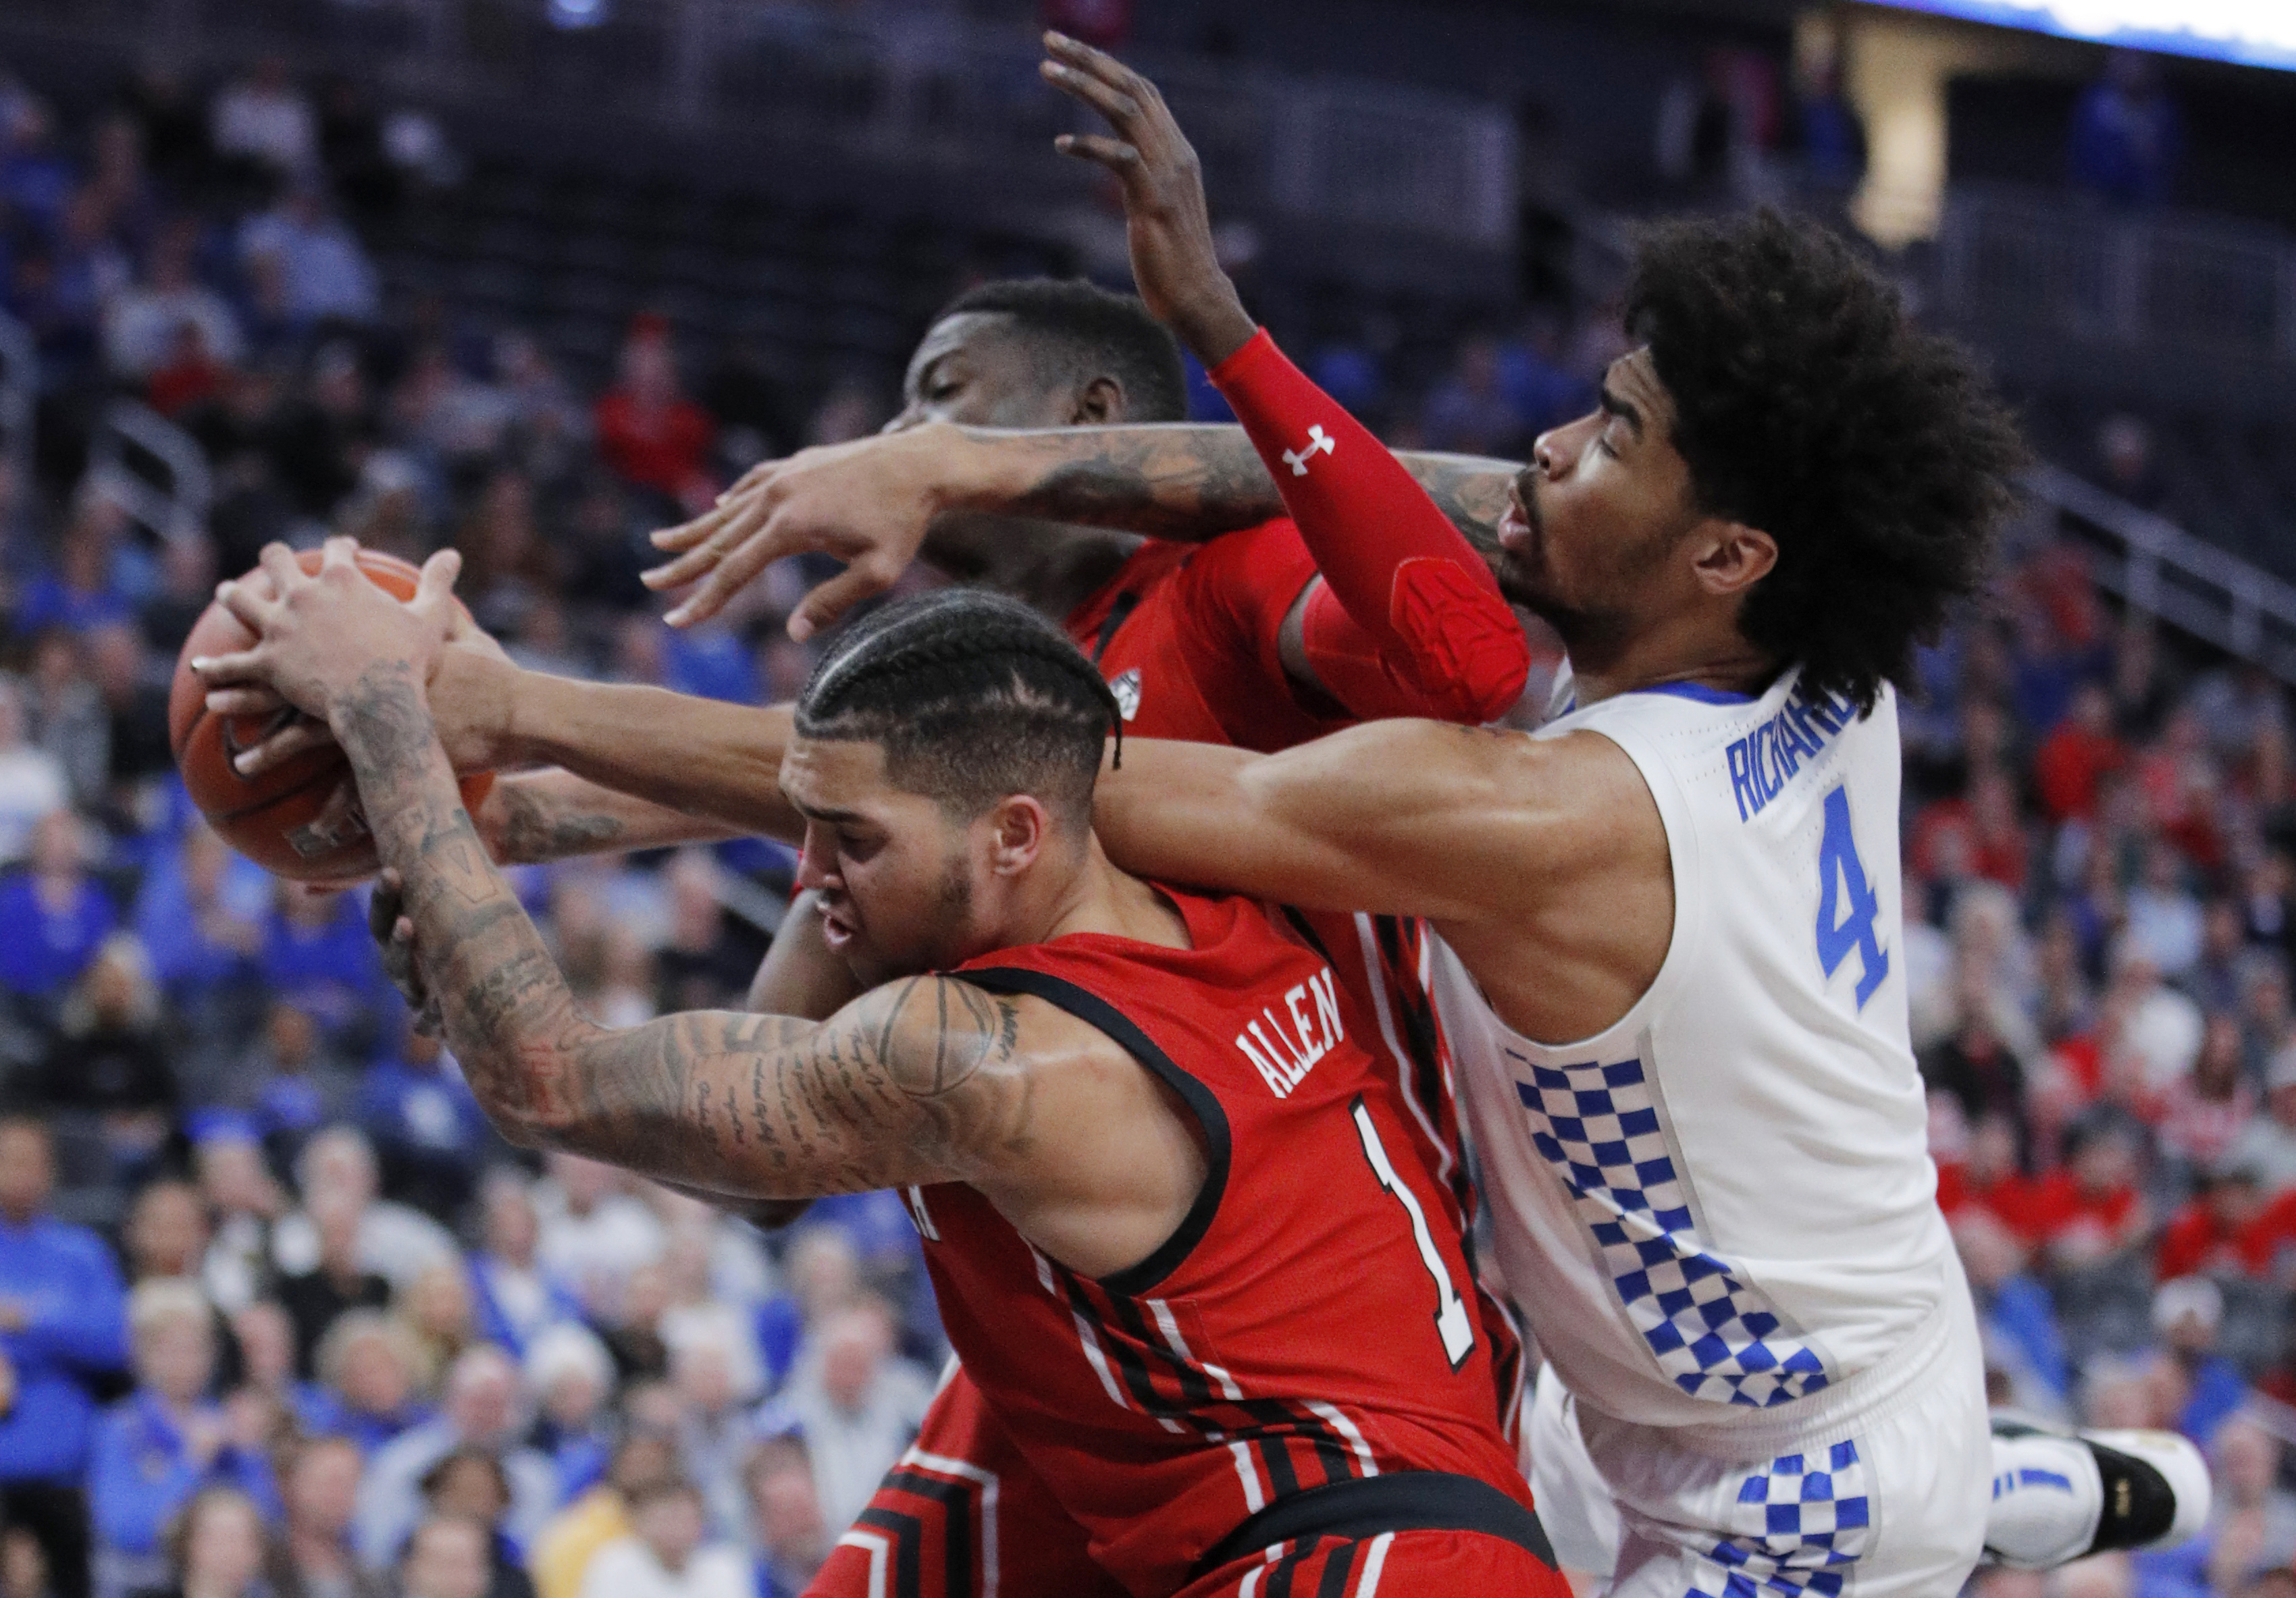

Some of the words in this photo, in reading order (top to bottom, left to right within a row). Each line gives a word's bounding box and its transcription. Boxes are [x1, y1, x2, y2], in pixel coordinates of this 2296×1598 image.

[1817, 784, 1889, 1013] 4
[1235, 967, 1344, 1099] ALLEN
[1347, 1092, 1476, 1375] 1
